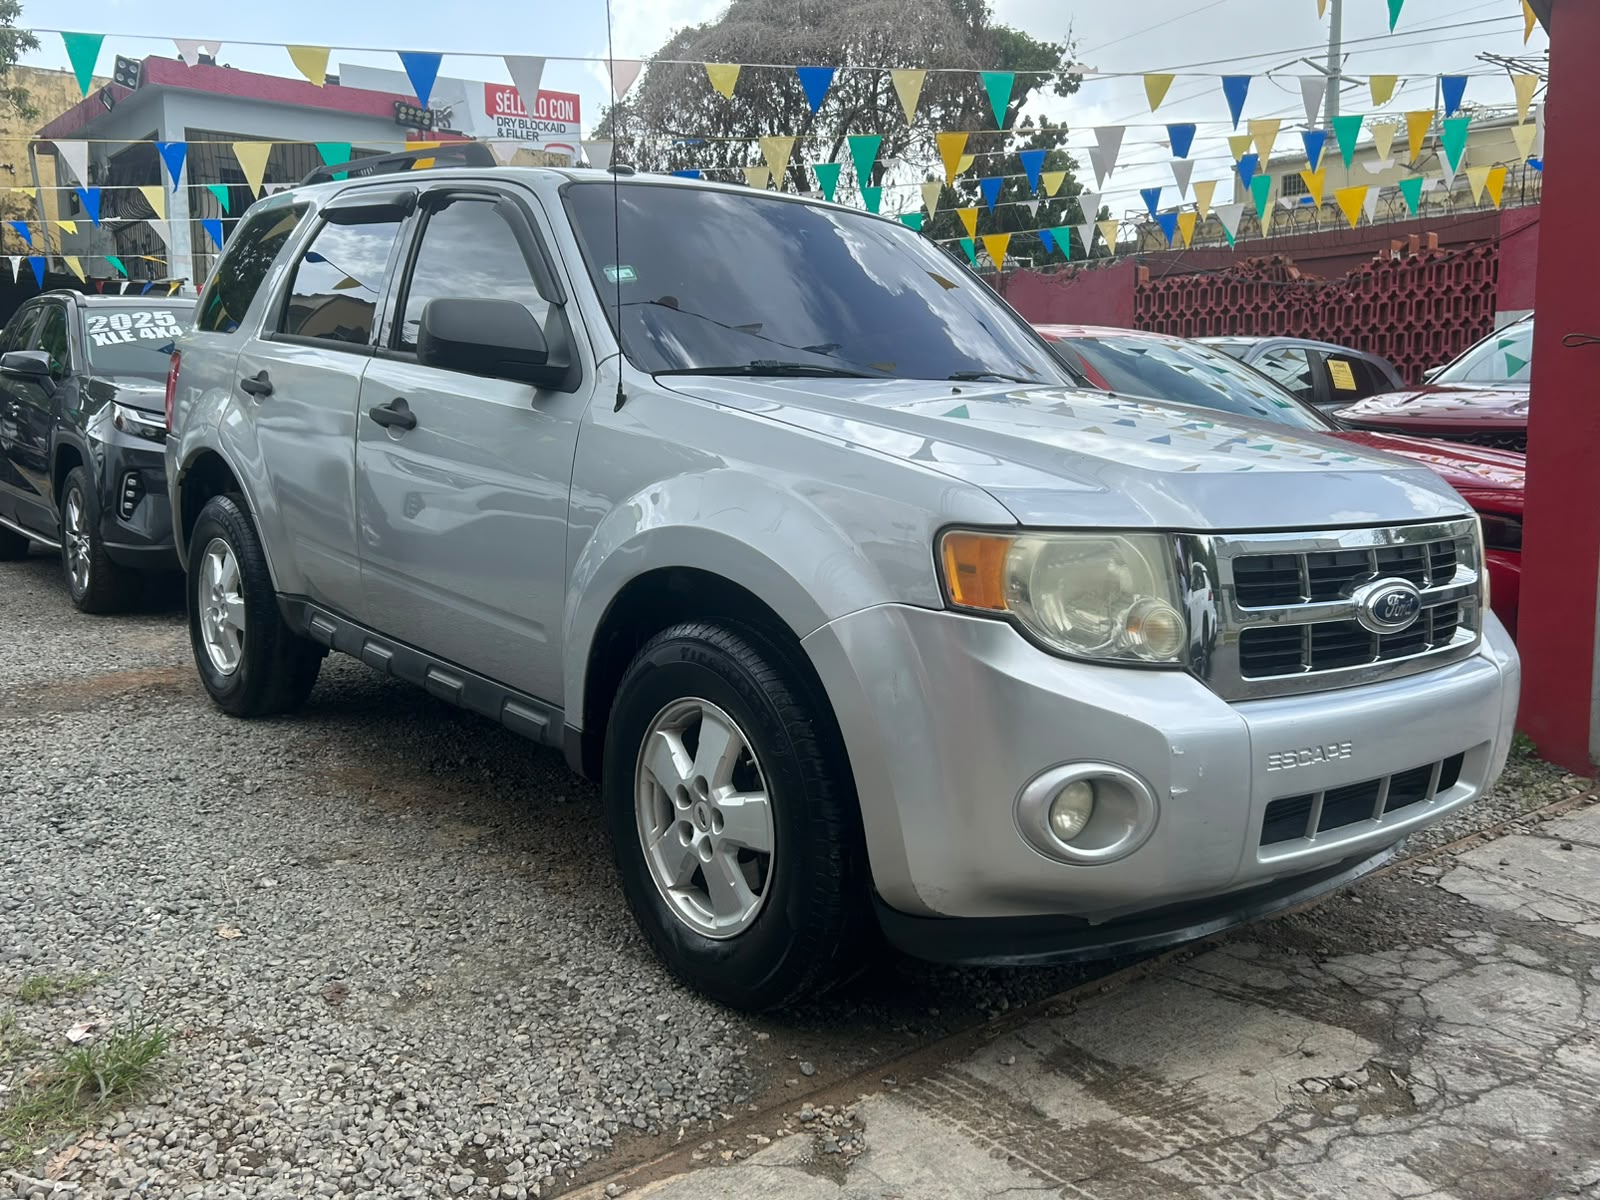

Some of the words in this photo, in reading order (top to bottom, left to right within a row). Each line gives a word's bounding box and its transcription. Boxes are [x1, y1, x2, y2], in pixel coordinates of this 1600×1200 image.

[496, 90, 547, 118] SÉLLLO
[550, 98, 574, 121] CON
[497, 117, 517, 128] DRY
[497, 128, 504, 138] &
[506, 129, 539, 141] FILLER
[87, 311, 176, 334] 2025
[91, 329, 137, 347] XLE
[140, 325, 183, 340] 4X4
[1384, 594, 1413, 618] Ford
[1267, 741, 1352, 771] ESCAPE
